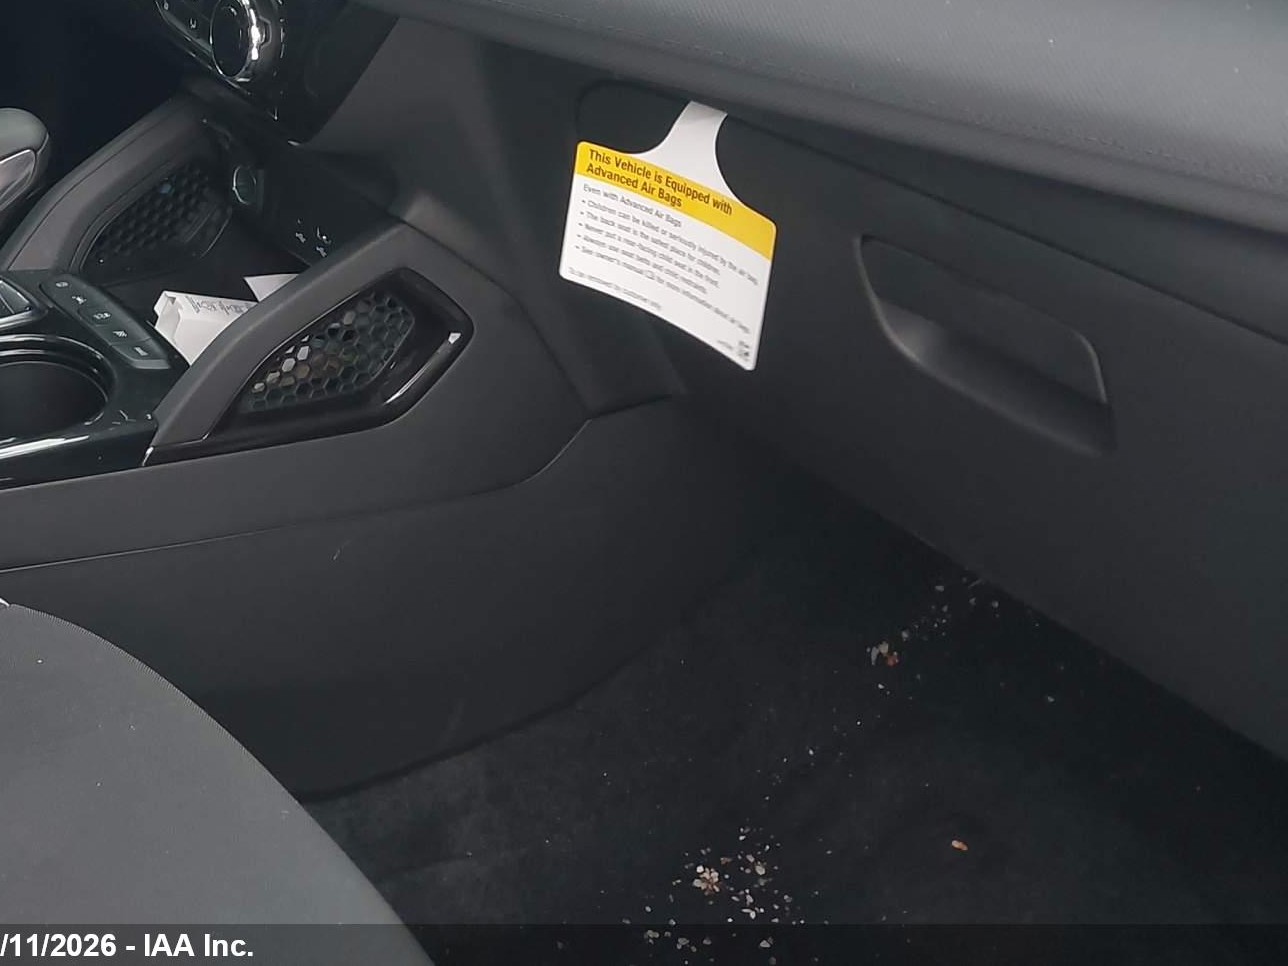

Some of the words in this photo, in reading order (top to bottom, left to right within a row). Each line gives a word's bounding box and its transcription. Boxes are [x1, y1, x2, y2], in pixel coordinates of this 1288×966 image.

[586, 162, 639, 189] Advanced
[640, 180, 657, 195] Air
[657, 187, 683, 208] Bags
[589, 148, 612, 165] This
[614, 156, 652, 180] Vehicle
[654, 170, 663, 184] is
[665, 175, 711, 204] Equipped
[712, 197, 733, 216] with
